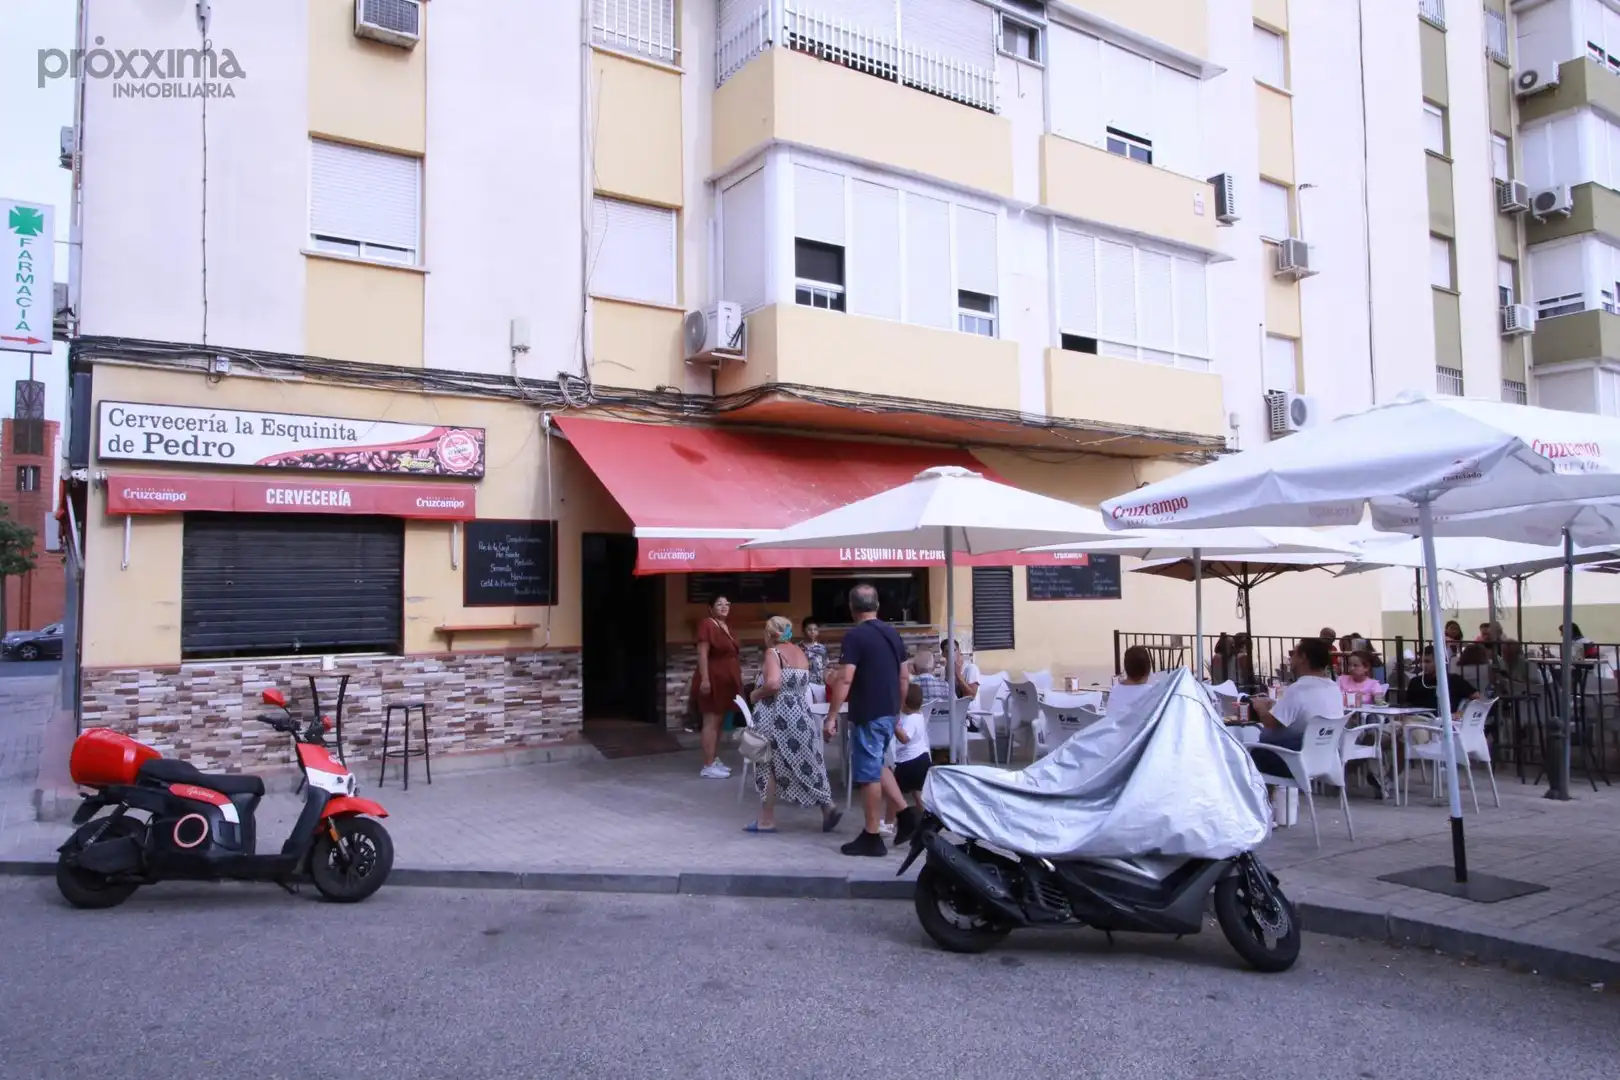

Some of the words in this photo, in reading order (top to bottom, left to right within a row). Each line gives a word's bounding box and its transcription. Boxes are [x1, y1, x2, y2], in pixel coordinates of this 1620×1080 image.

[15, 237, 34, 332] FARMACIA
[107, 407, 228, 434] Cervecería
[235, 415, 254, 435] la
[260, 418, 358, 443] Esquinita
[107, 434, 134, 453] de
[142, 431, 235, 458] Pedro
[123, 487, 187, 502] Cruzcampo
[265, 488, 352, 507] CERVECERÍA
[415, 497, 465, 510] Cruzcampo
[1111, 496, 1189, 520] Cruzcampo
[647, 549, 696, 561] Cruzcampo
[839, 547, 852, 560] LA
